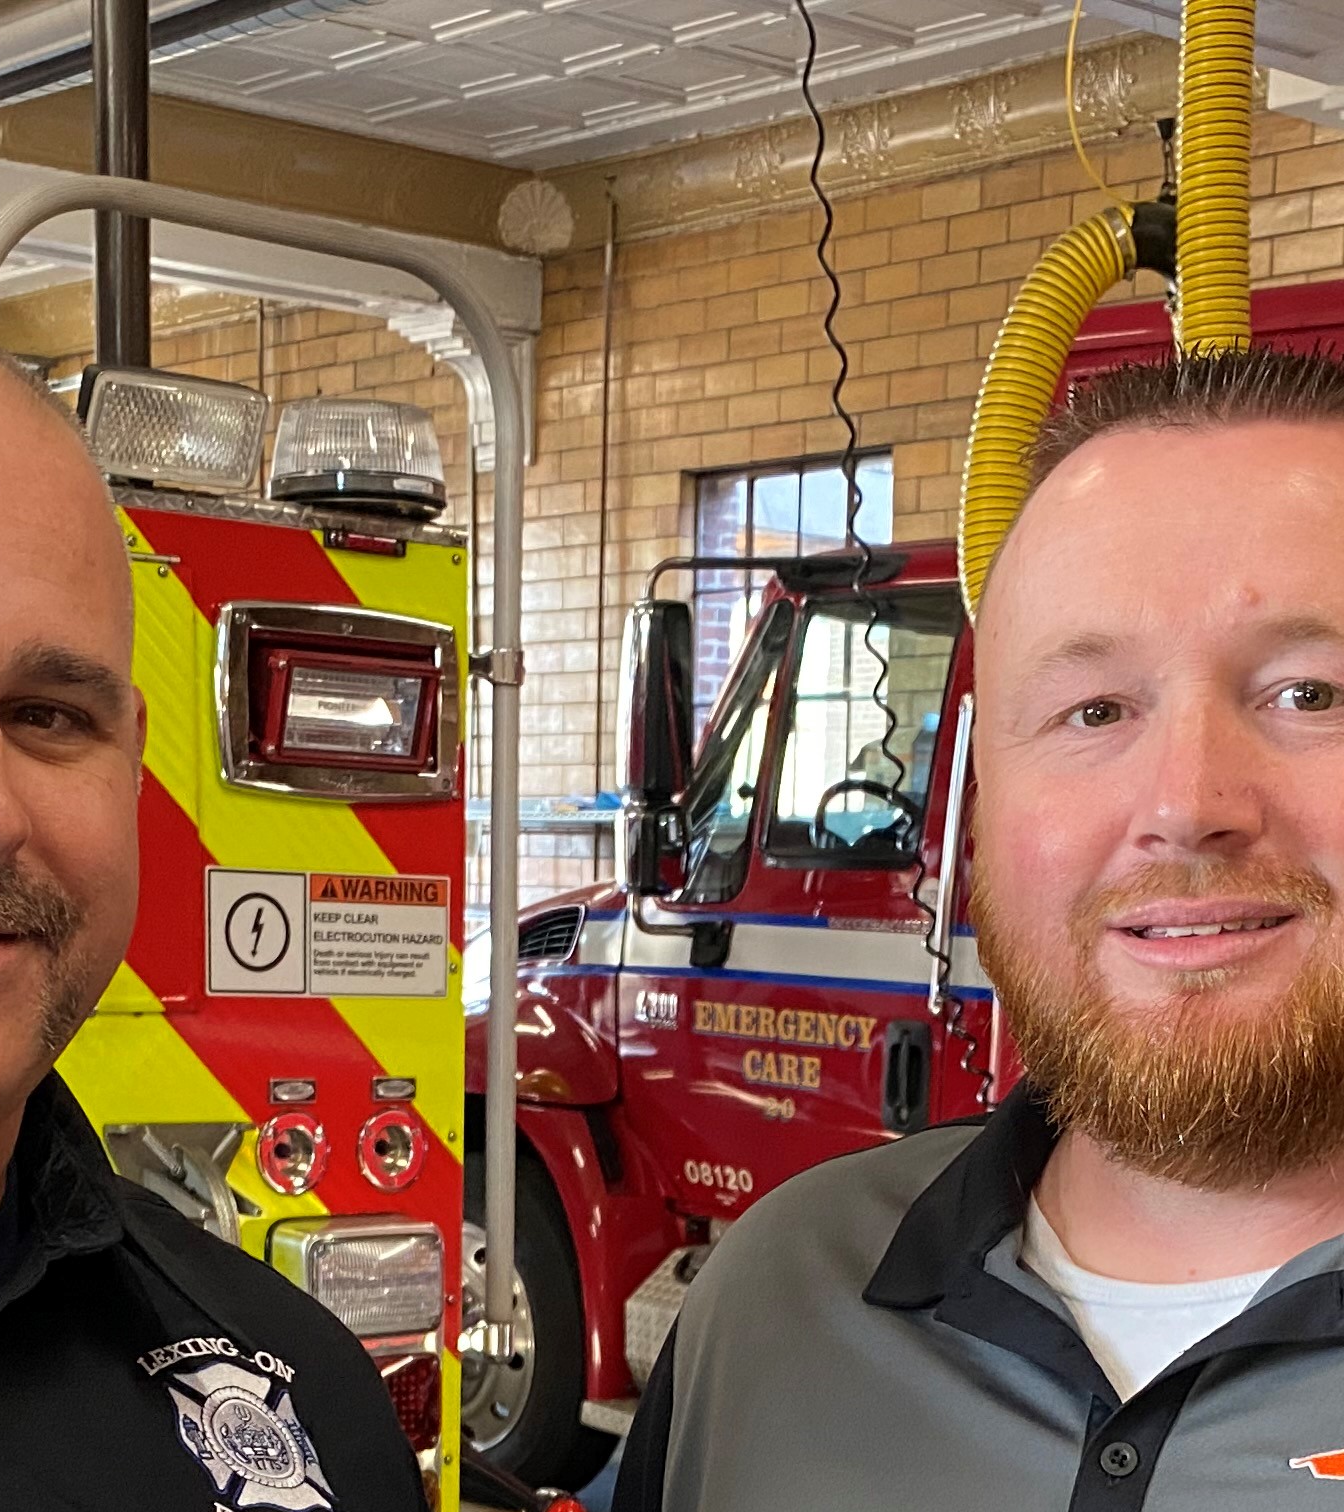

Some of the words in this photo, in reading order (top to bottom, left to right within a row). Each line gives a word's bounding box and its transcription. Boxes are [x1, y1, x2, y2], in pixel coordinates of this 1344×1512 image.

[340, 879, 439, 903] WARNING
[313, 912, 340, 923] KEEP
[344, 913, 378, 925] CLEAR
[313, 930, 399, 944] ELECTROCUTION
[402, 933, 444, 946] HAZARD
[693, 1000, 878, 1050] EMERGENCY
[742, 1050, 821, 1088] CARE
[683, 1159, 754, 1193] 08120
[136, 1337, 296, 1384] LEXINGON
